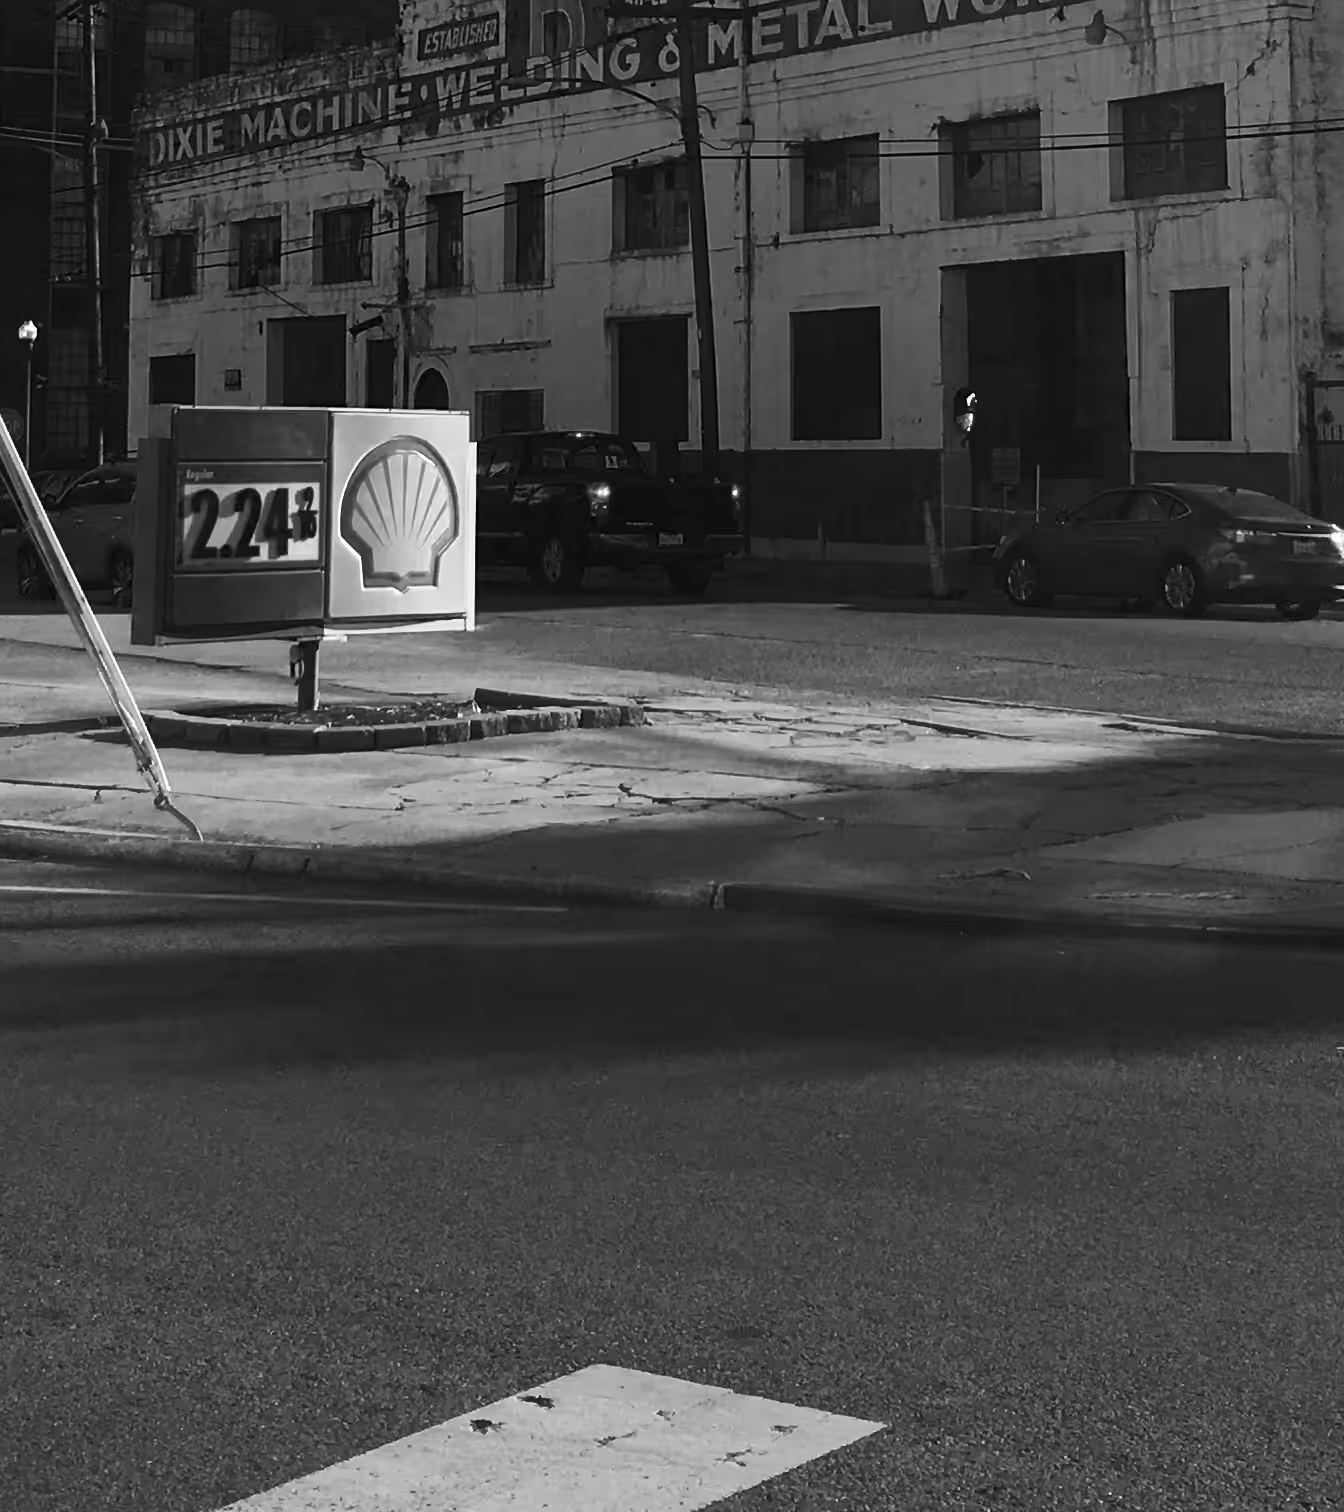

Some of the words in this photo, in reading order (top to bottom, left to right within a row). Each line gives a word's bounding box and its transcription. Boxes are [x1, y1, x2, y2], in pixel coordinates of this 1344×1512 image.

[424, 19, 499, 55] ESTABLISHED
[149, 117, 225, 168] DIXIE
[240, 82, 412, 148] MACHINE
[436, 37, 641, 112] WELDING
